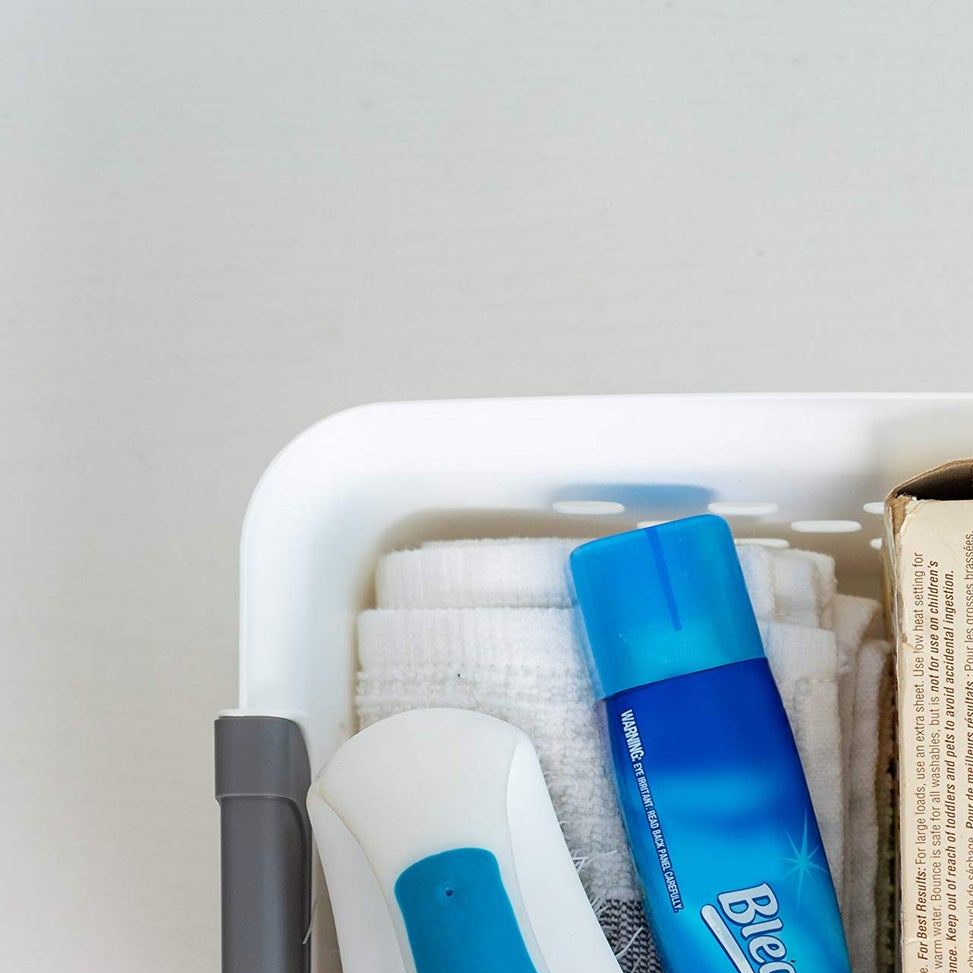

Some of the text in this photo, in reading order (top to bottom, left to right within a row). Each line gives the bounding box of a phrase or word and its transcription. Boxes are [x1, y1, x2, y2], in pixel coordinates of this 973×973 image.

[912, 552, 923, 567] for
[912, 571, 926, 606] setting
[943, 571, 956, 624] ingestion.
[913, 610, 924, 631] heat
[913, 657, 924, 677] Use
[943, 627, 954, 684] accidental
[913, 681, 925, 712] sheet.
[943, 687, 955, 717] avoid
[914, 716, 925, 741] extra
[944, 721, 955, 730] to
[916, 745, 925, 758] an
[945, 734, 957, 758] pets
[916, 761, 925, 779] use
[944, 760, 955, 780] and
[621, 709, 684, 912] WARNING: EYE IRRITANT. READ BACK PANEL CAREFULLY.
[914, 784, 927, 814] loads,
[945, 784, 956, 828] toddlers
[915, 818, 928, 844] large
[945, 831, 956, 842] of
[915, 848, 926, 864] For
[945, 846, 956, 876] reach
[916, 868, 927, 912] Results:
[945, 879, 956, 890] of
[946, 893, 956, 910] out
[917, 915, 927, 939] Best
[946, 914, 959, 941] Keep
[918, 942, 928, 960] For
